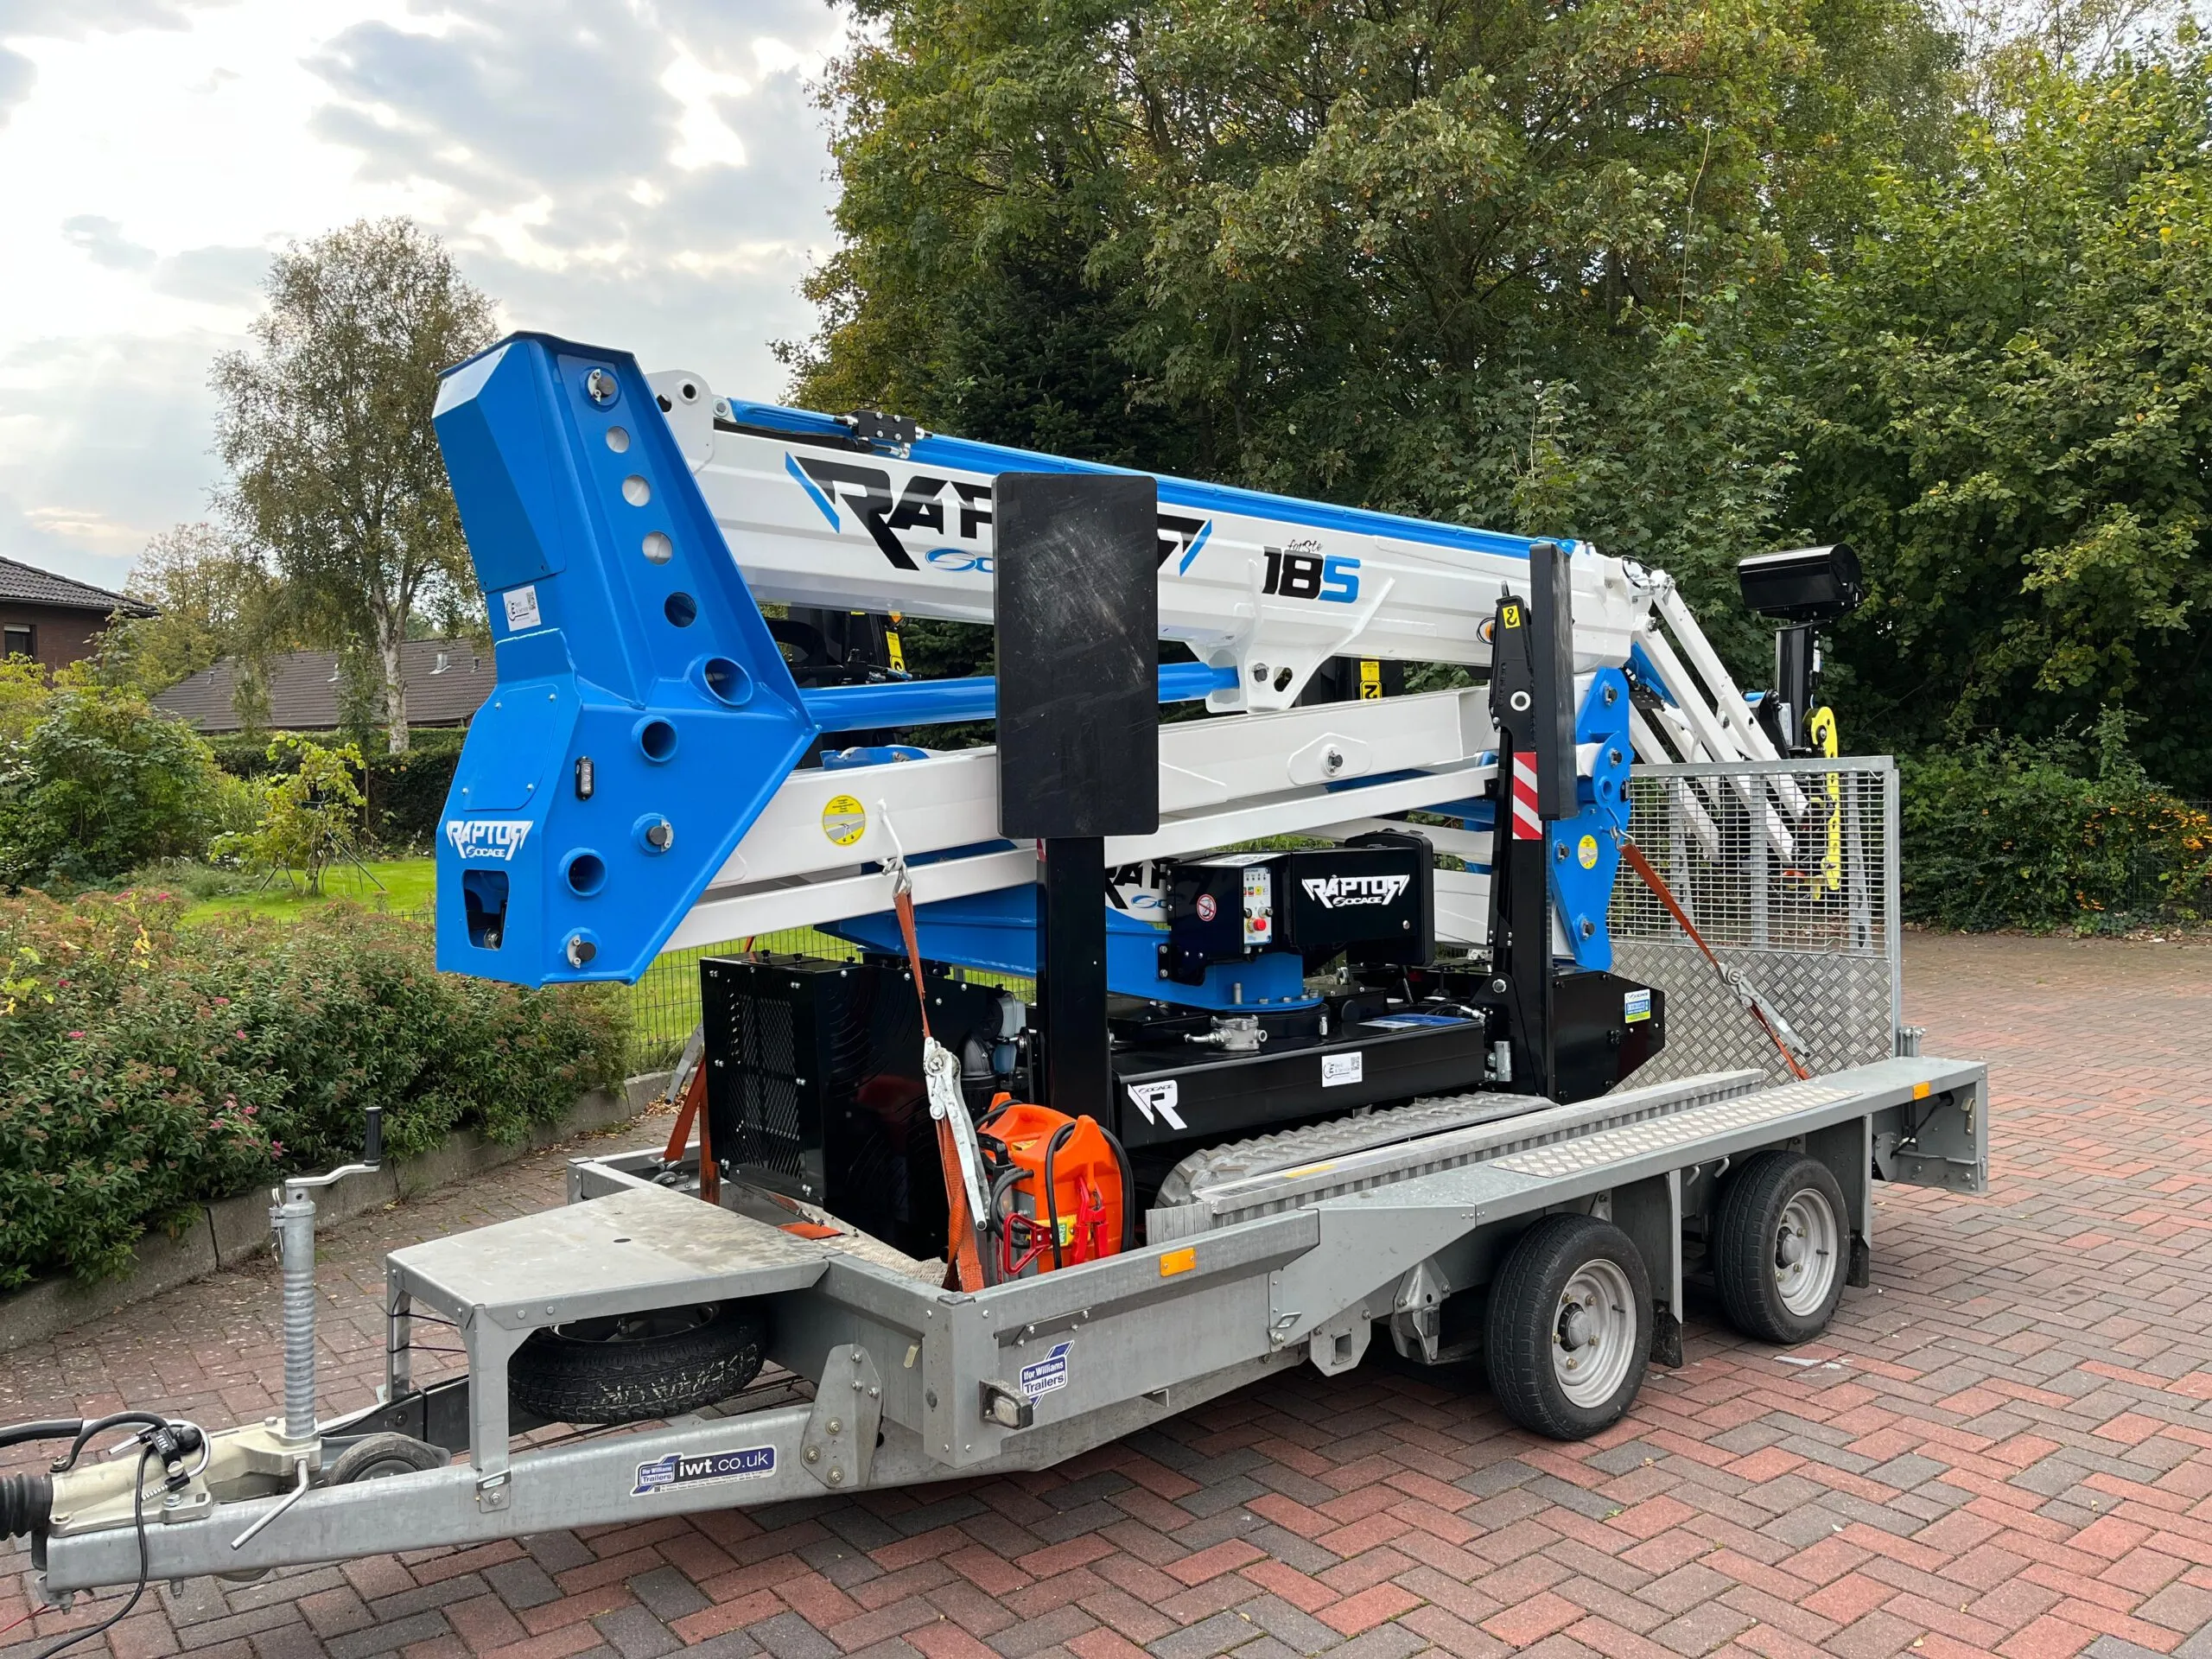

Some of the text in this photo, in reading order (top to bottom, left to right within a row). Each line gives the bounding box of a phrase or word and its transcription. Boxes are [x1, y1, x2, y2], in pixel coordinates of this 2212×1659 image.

[446, 820, 533, 861] RAPTOR
[466, 845, 505, 858] SOCAGE
[1301, 874, 1410, 908] RAPTOR
[1332, 896, 1382, 907] SOCAGE
[1023, 1361, 1064, 1381] Ifor Williams
[1025, 1375, 1065, 1394] Trailers
[679, 1452, 768, 1477] iwt.co.uk
[643, 1474, 672, 1483] Trailers
